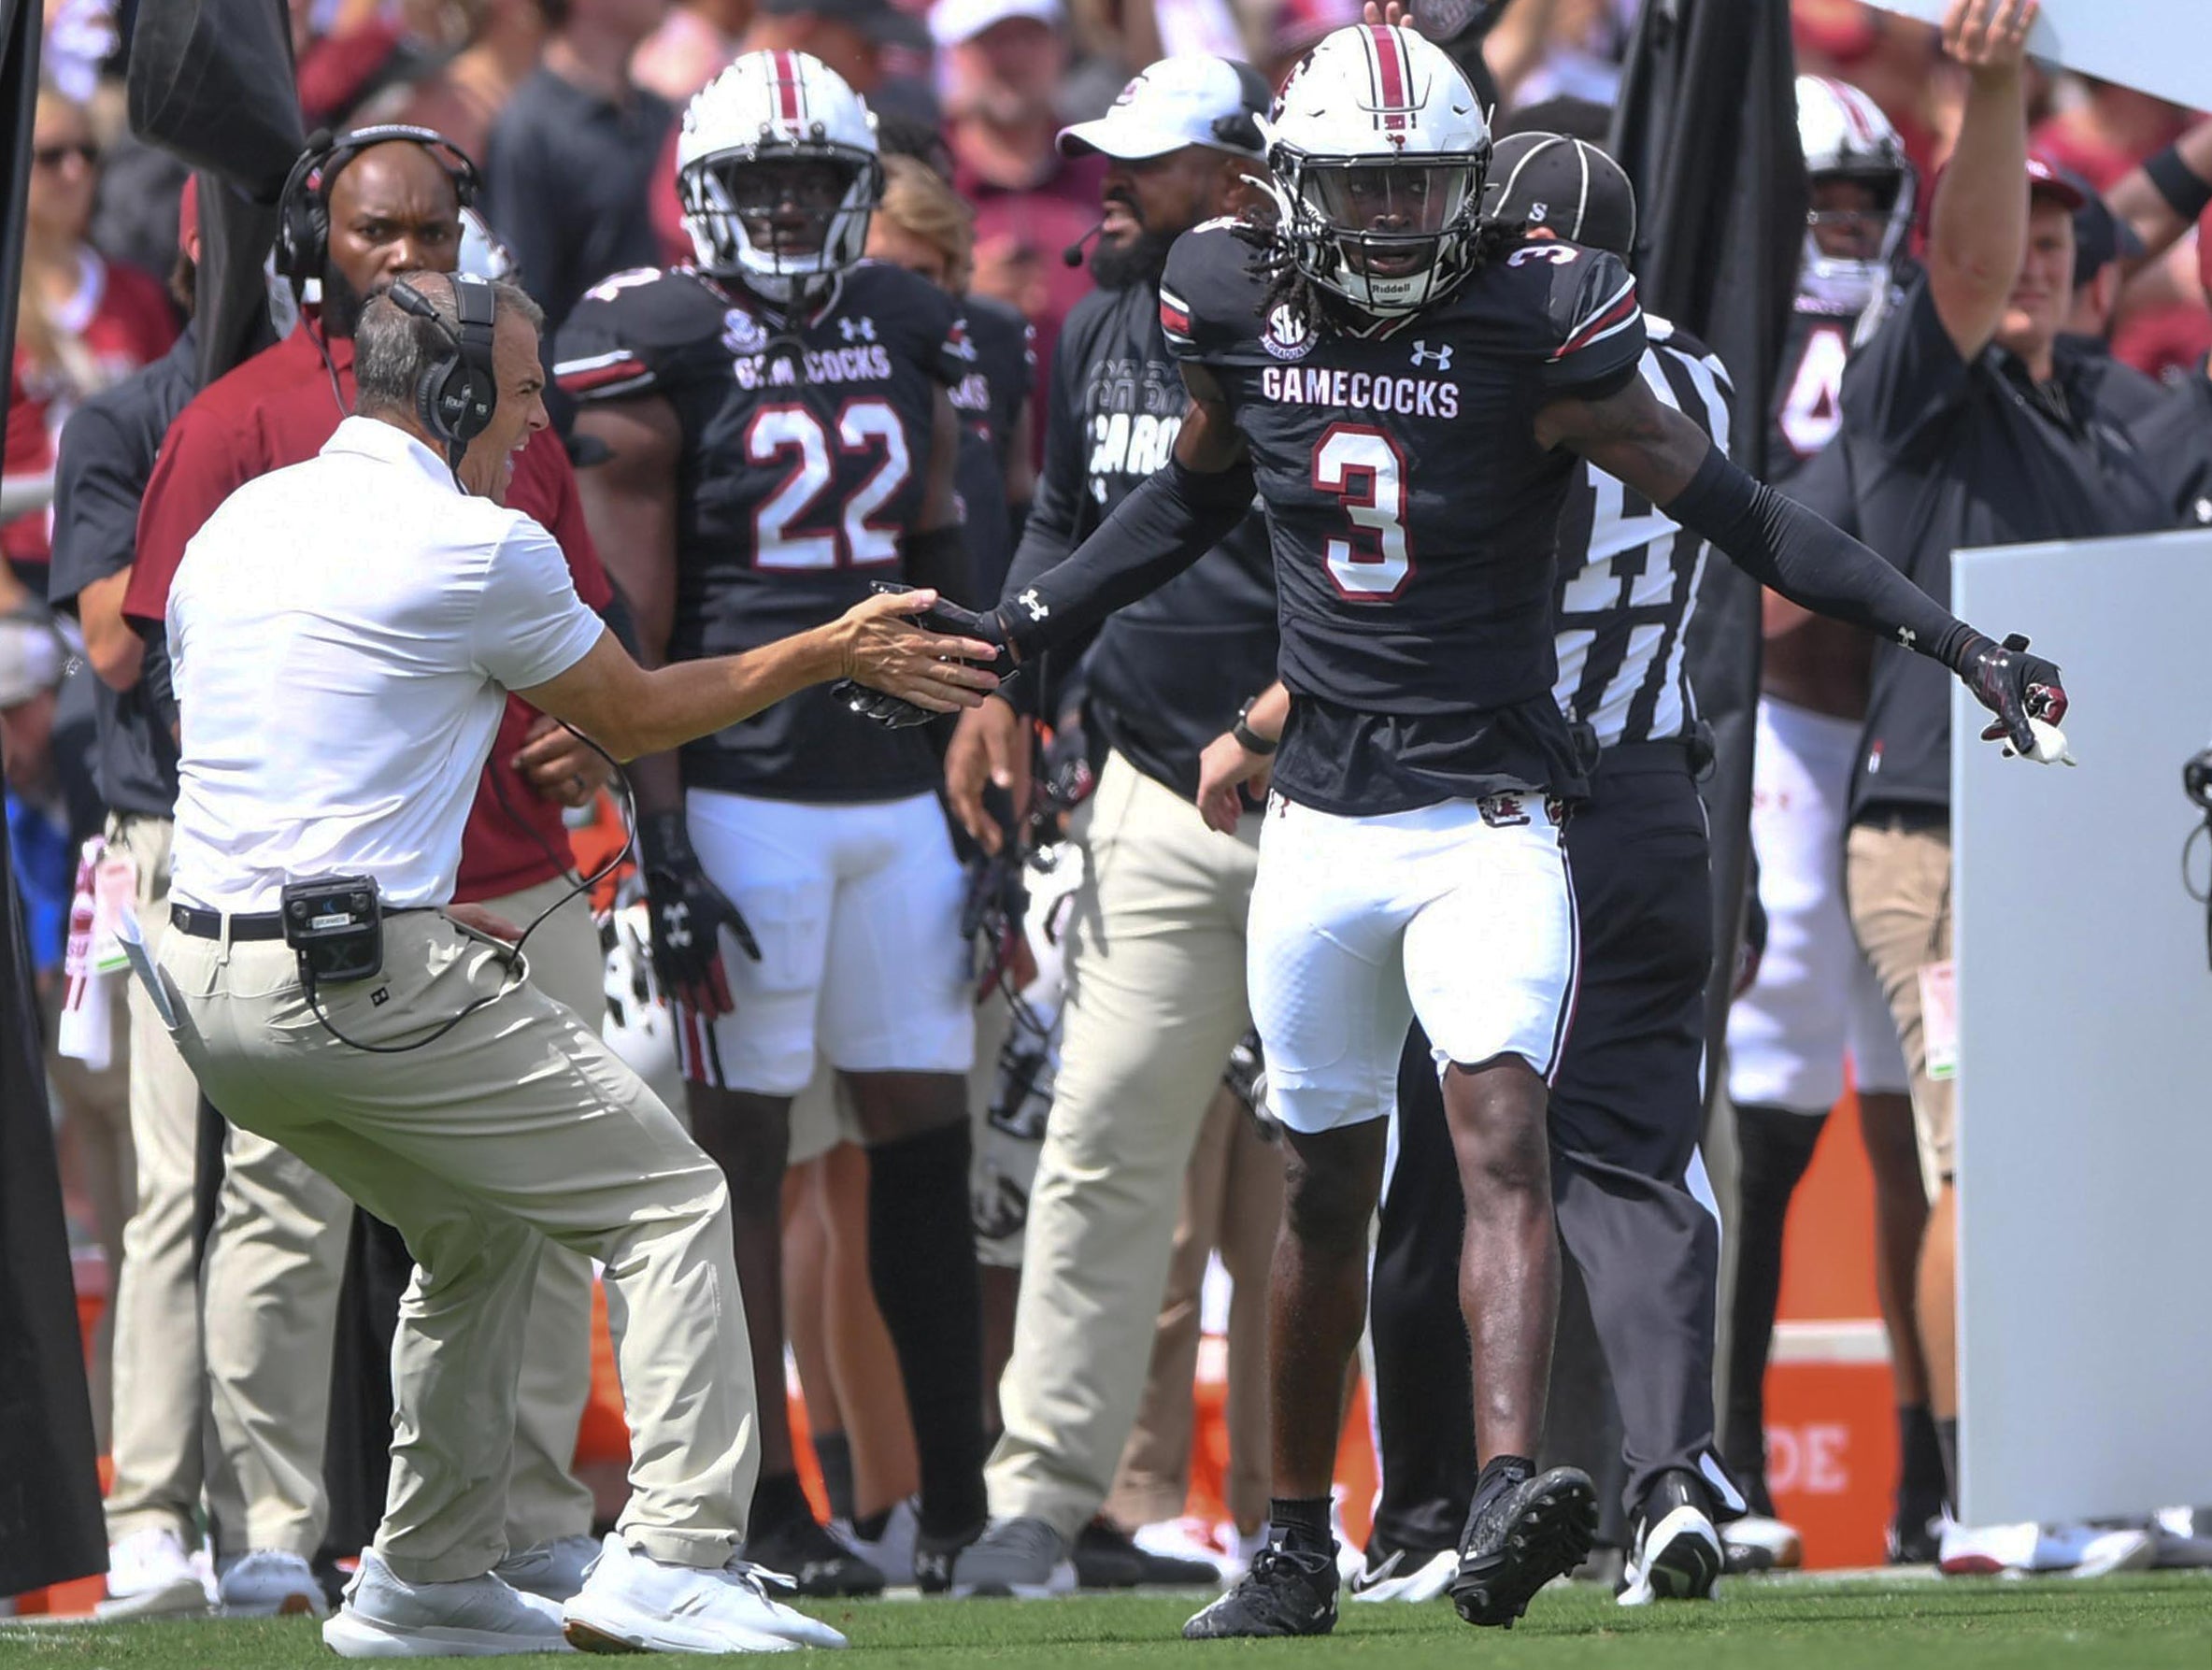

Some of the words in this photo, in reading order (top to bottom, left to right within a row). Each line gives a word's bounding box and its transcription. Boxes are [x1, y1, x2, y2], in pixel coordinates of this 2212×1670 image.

[1528, 202, 1548, 221] S
[1372, 282, 1411, 293] Riddell
[1262, 365, 1461, 420] GAMECOCKS
[744, 394, 912, 572] 22
[1311, 421, 1418, 603] 3
